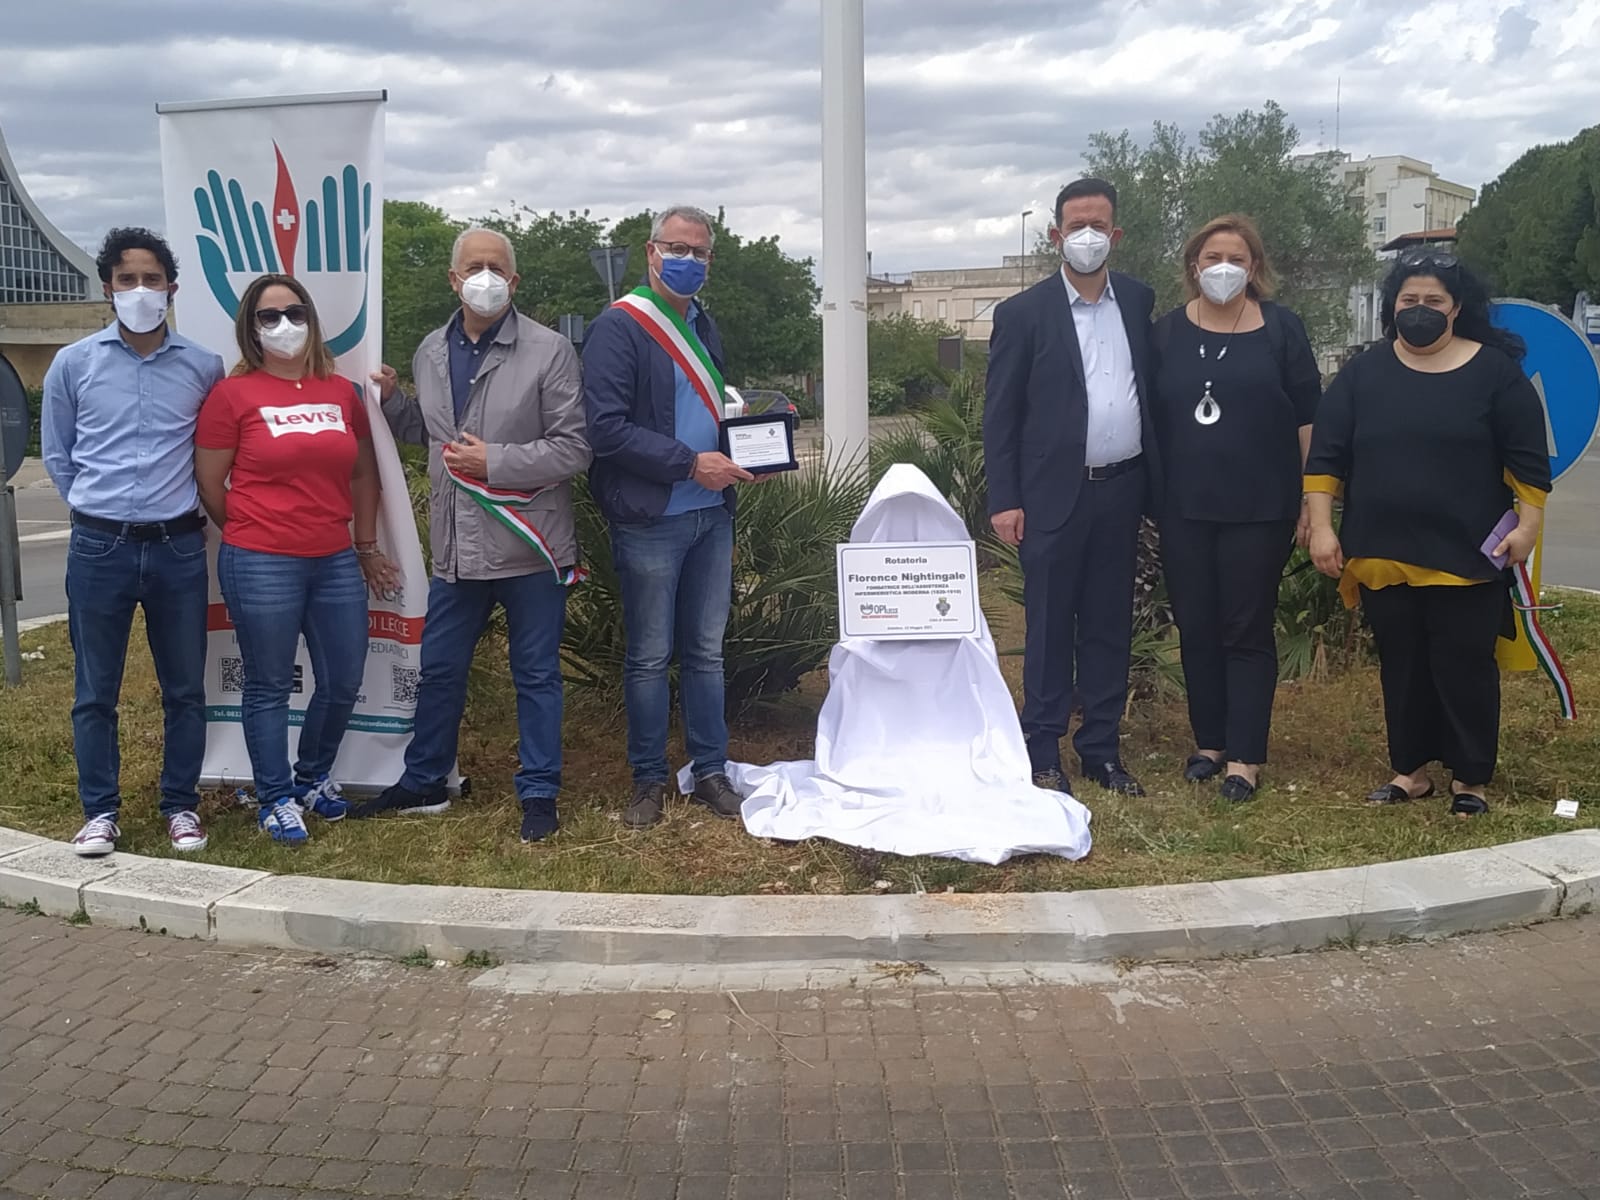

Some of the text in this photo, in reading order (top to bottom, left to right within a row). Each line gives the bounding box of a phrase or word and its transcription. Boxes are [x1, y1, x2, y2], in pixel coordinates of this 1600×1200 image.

[884, 556, 928, 565] Rotatoria
[848, 571, 966, 583] Florence Nightingale
[381, 616, 411, 637] LECCE
